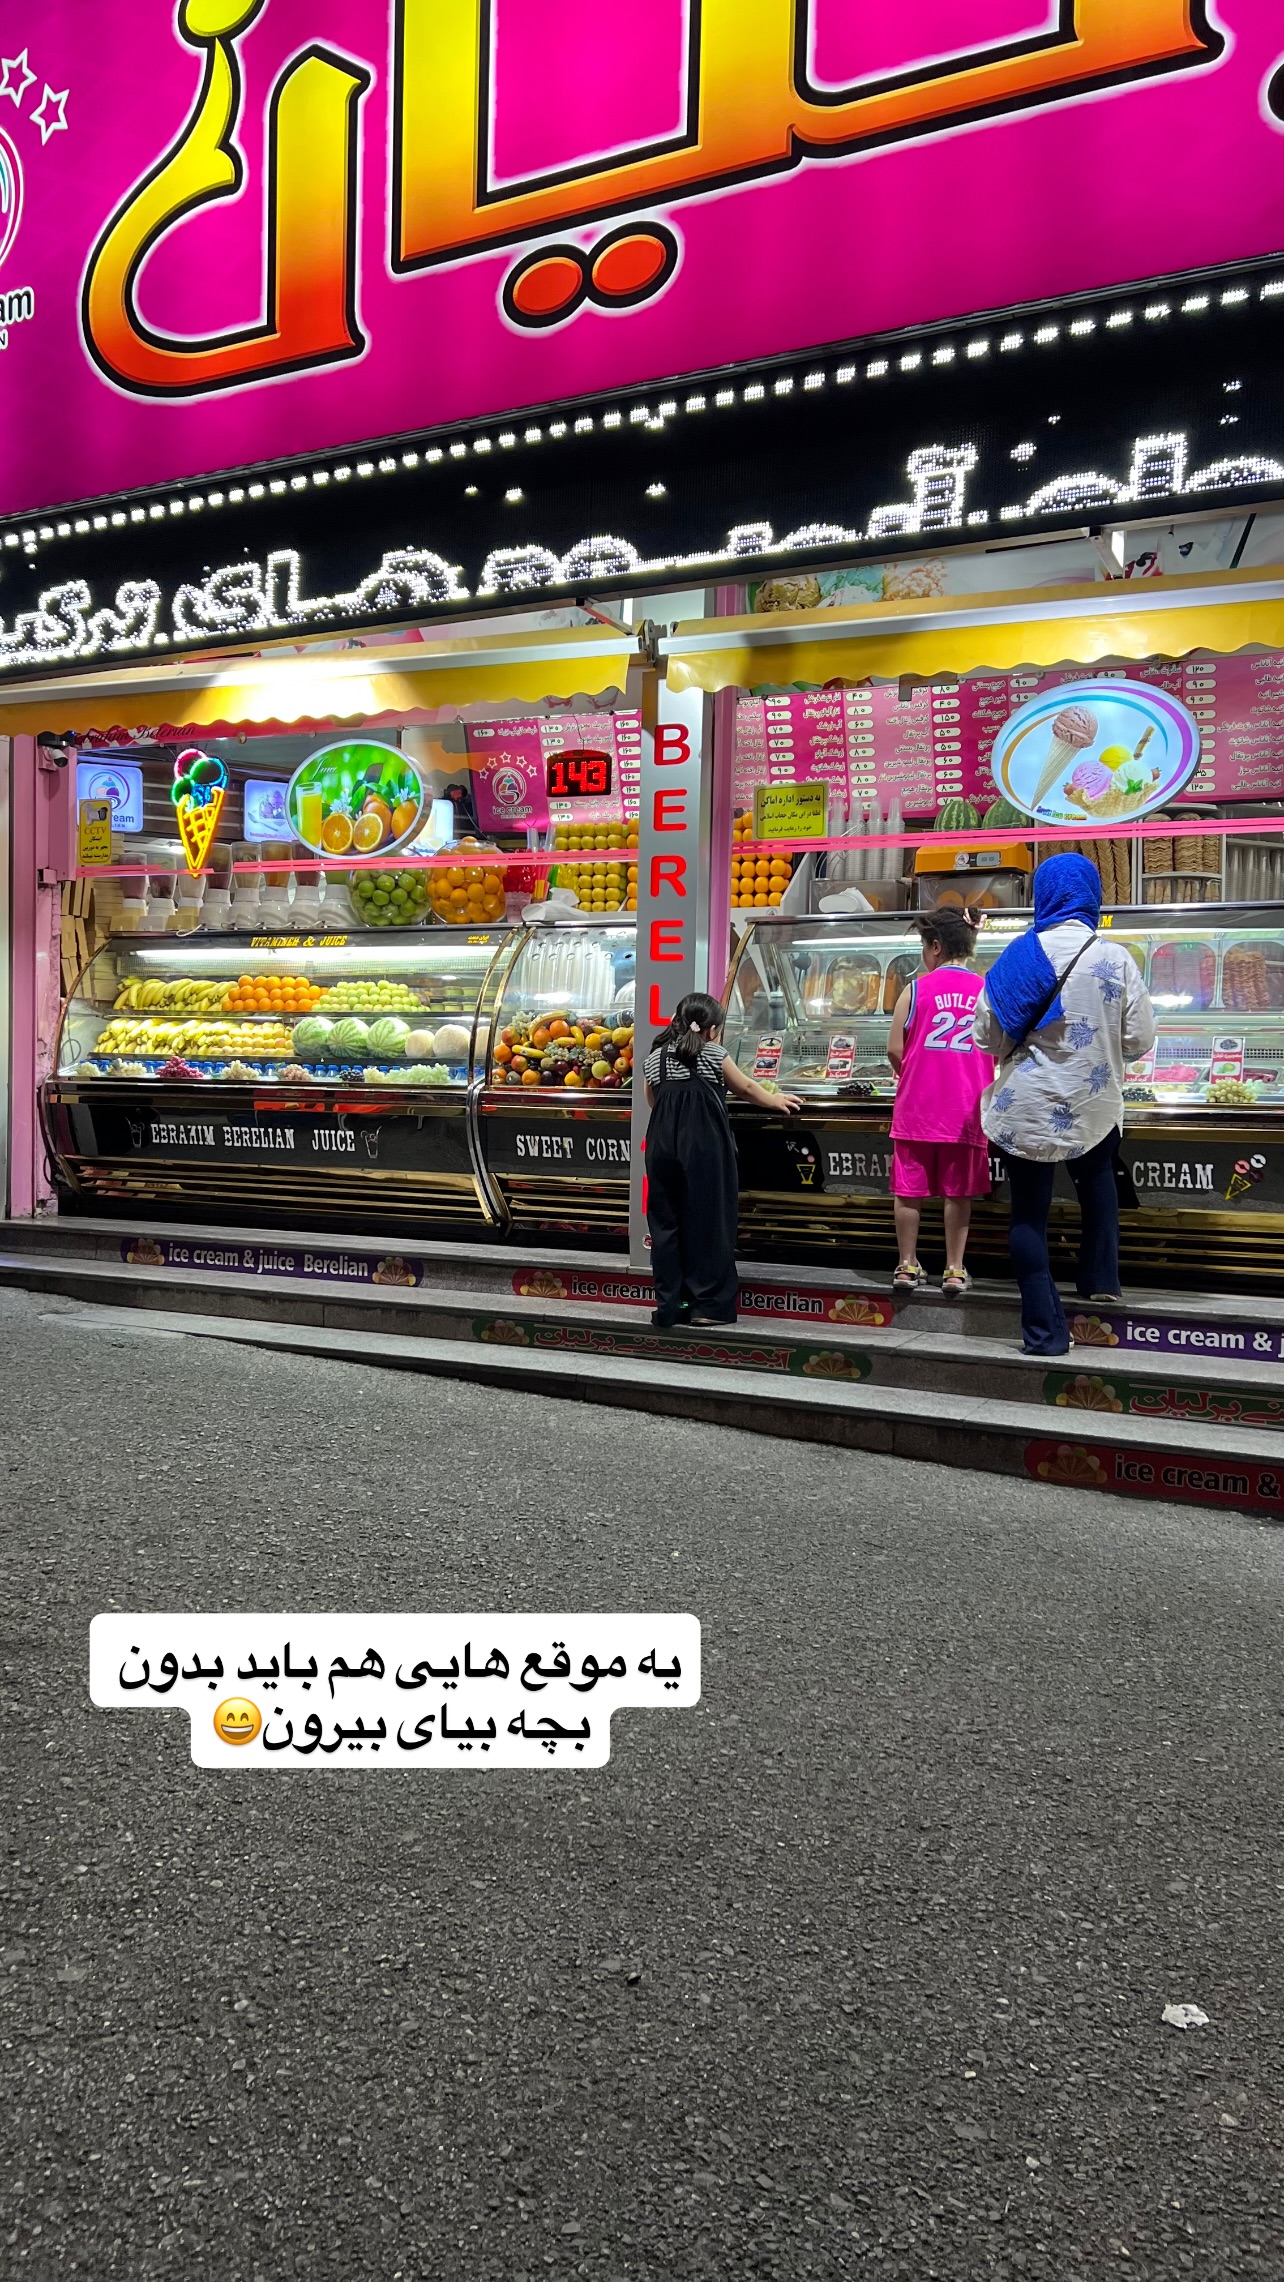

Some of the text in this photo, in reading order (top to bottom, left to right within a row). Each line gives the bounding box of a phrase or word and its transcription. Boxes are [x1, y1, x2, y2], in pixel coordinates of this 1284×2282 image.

[551, 760, 607, 793] 143
[506, 805, 533, 815] cream
[779, 794, 795, 807] اداره
[796, 795, 814, 806] دستور
[84, 827, 107, 835] CCTV
[303, 936, 315, 946] &
[320, 935, 347, 946] JUICE
[924, 1011, 976, 1053] 22
[222, 1126, 295, 1149] BERELIAN
[312, 1129, 356, 1152] JUICE
[516, 1134, 631, 1162] SWEET CORN
[1132, 1161, 1214, 1189] CREAM
[168, 1243, 368, 1277] ice cream & juice Berelian
[572, 1275, 823, 1314] ice cream Berelian
[534, 1326, 616, 1352] برلیان
[1126, 1321, 1160, 1343] ice
[1167, 1328, 1245, 1350] cream
[1252, 1331, 1273, 1352] &
[1129, 1387, 1242, 1424] برلیان
[1115, 1453, 1281, 1500] ice cream &
